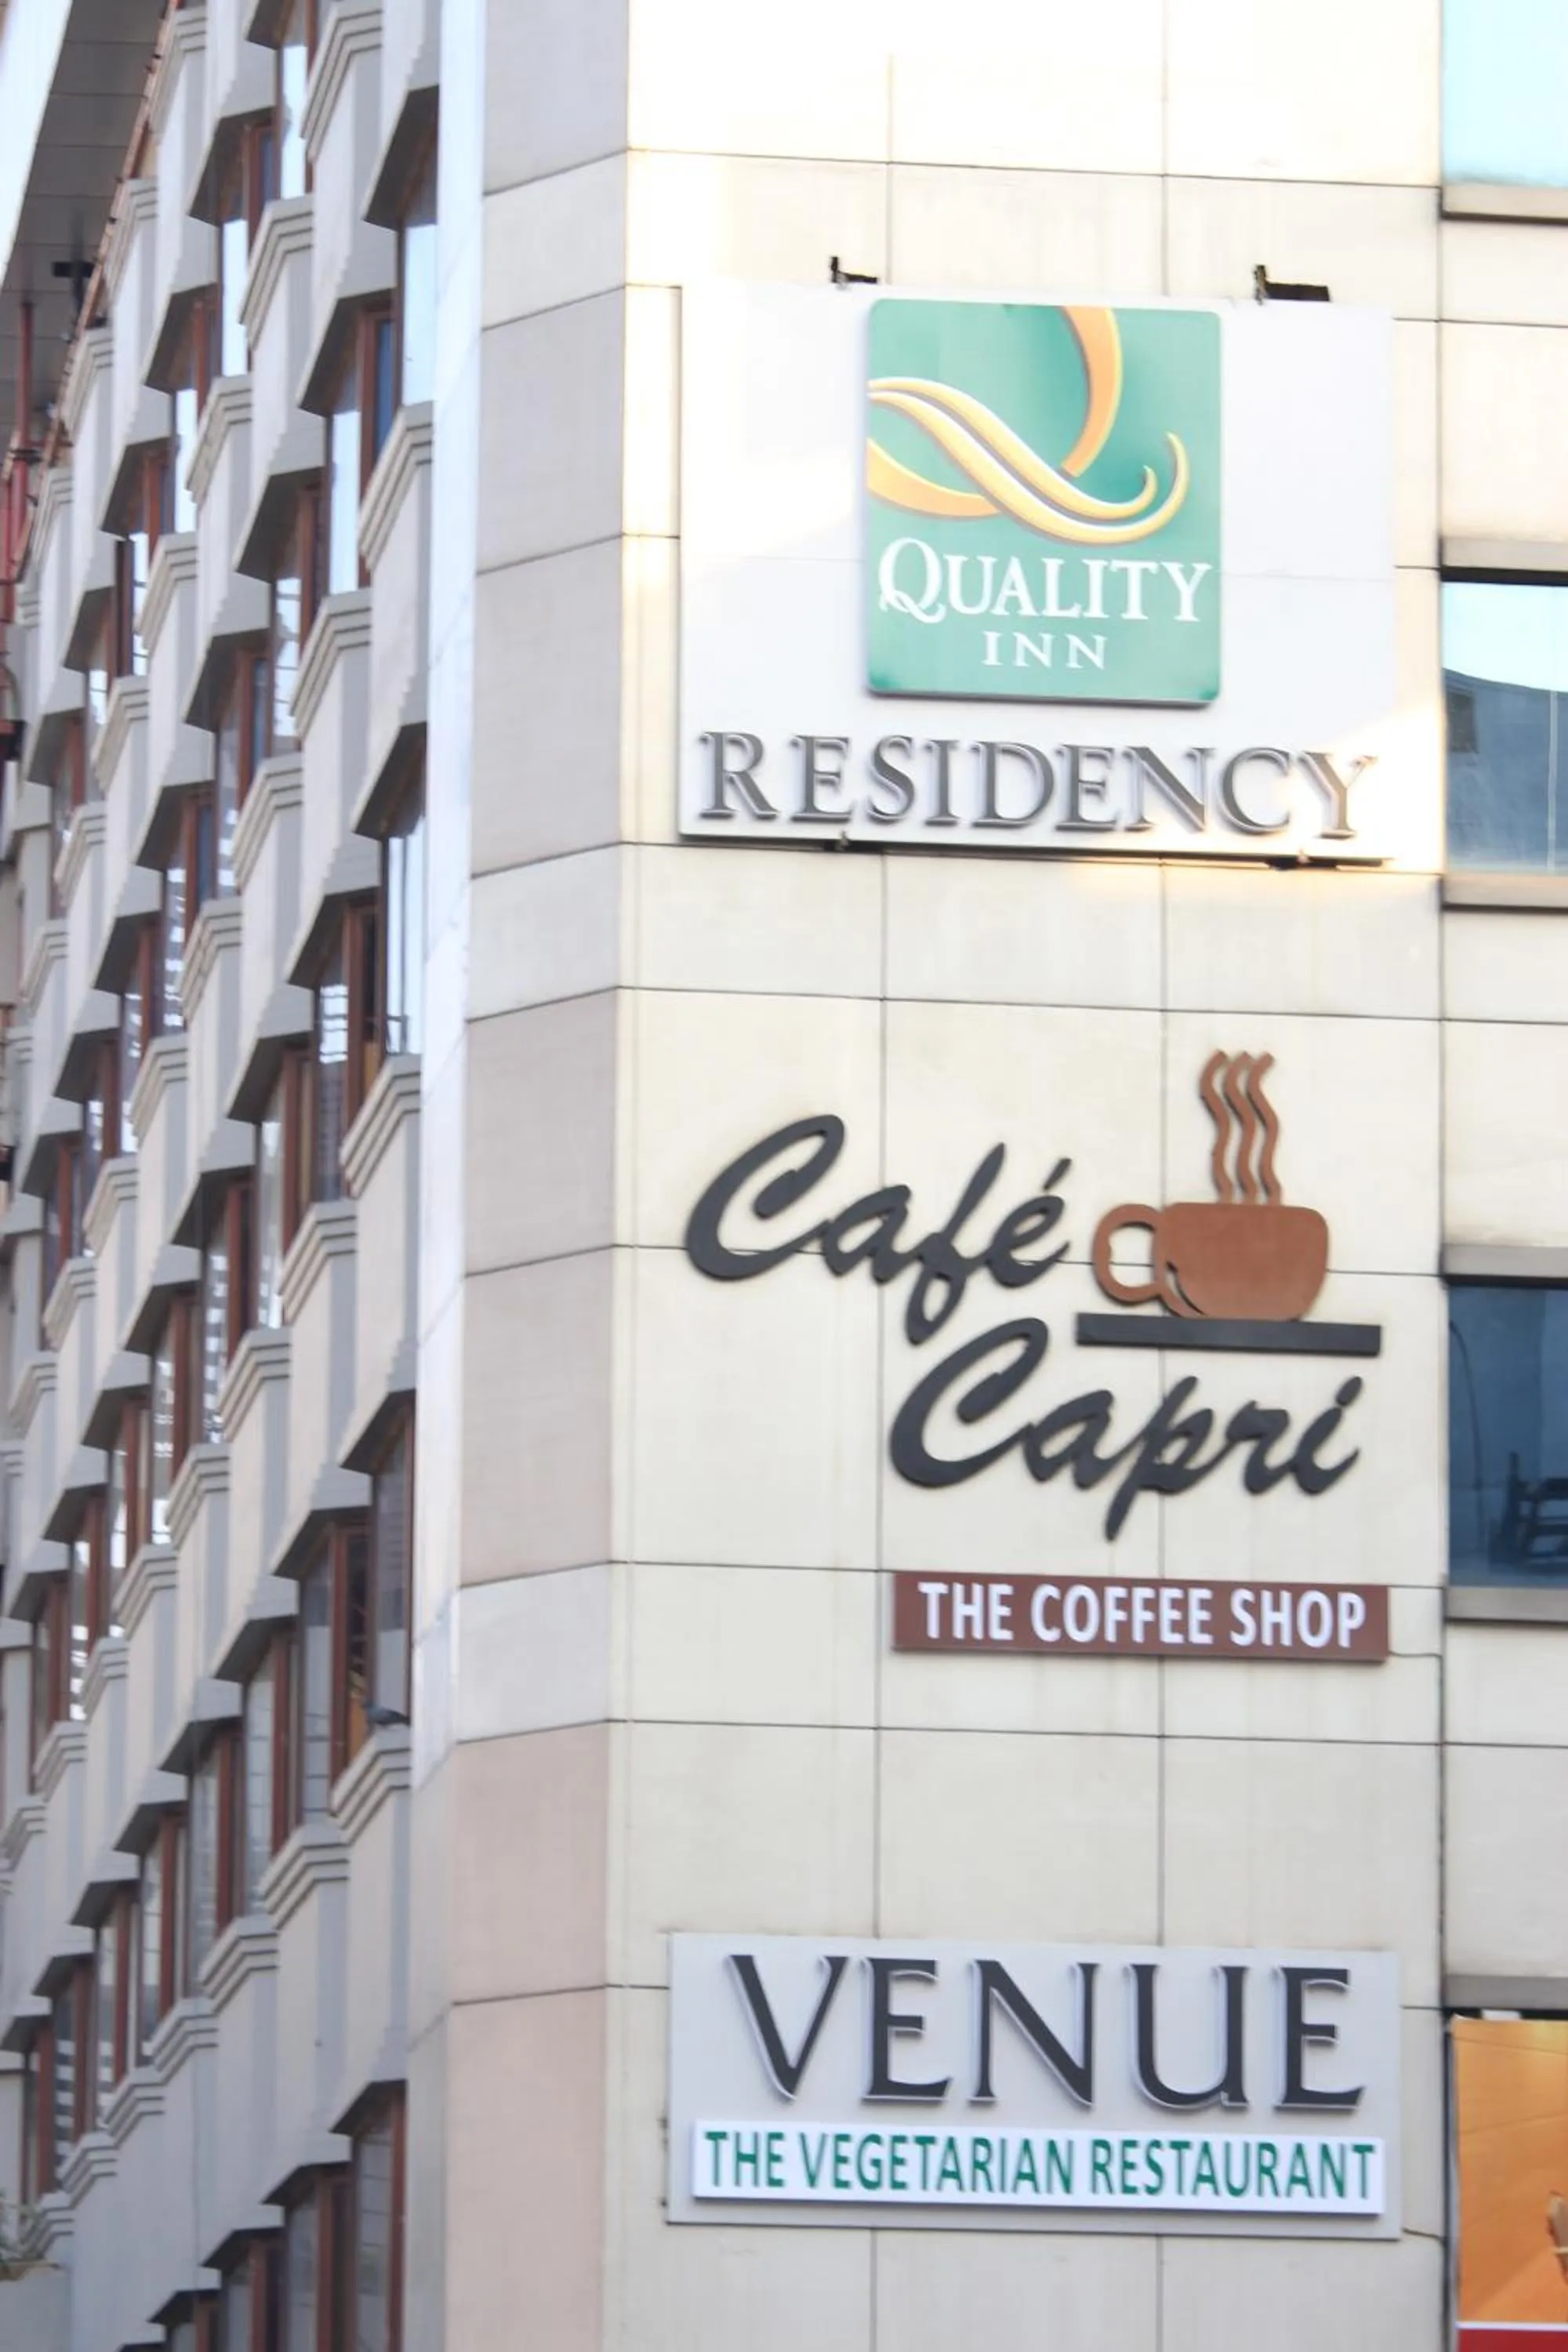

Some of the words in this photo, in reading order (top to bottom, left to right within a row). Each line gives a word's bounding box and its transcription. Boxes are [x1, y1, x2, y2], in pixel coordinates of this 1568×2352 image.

[877, 536, 1212, 624] QUALITY
[982, 630, 1108, 670] INN
[698, 730, 1377, 840] RESIDENCY
[684, 1113, 1073, 1346] Café
[888, 1316, 1363, 1542] Capri
[918, 1581, 1014, 1640] THE
[1030, 1584, 1213, 1645] COFFEE
[1229, 1589, 1367, 1649] SHOP
[724, 1953, 1365, 2111] VENUE
[705, 2129, 785, 2188] THE
[799, 2132, 1075, 2196] VEGETARIAN
[1091, 2137, 1376, 2201] RESTAURANT
